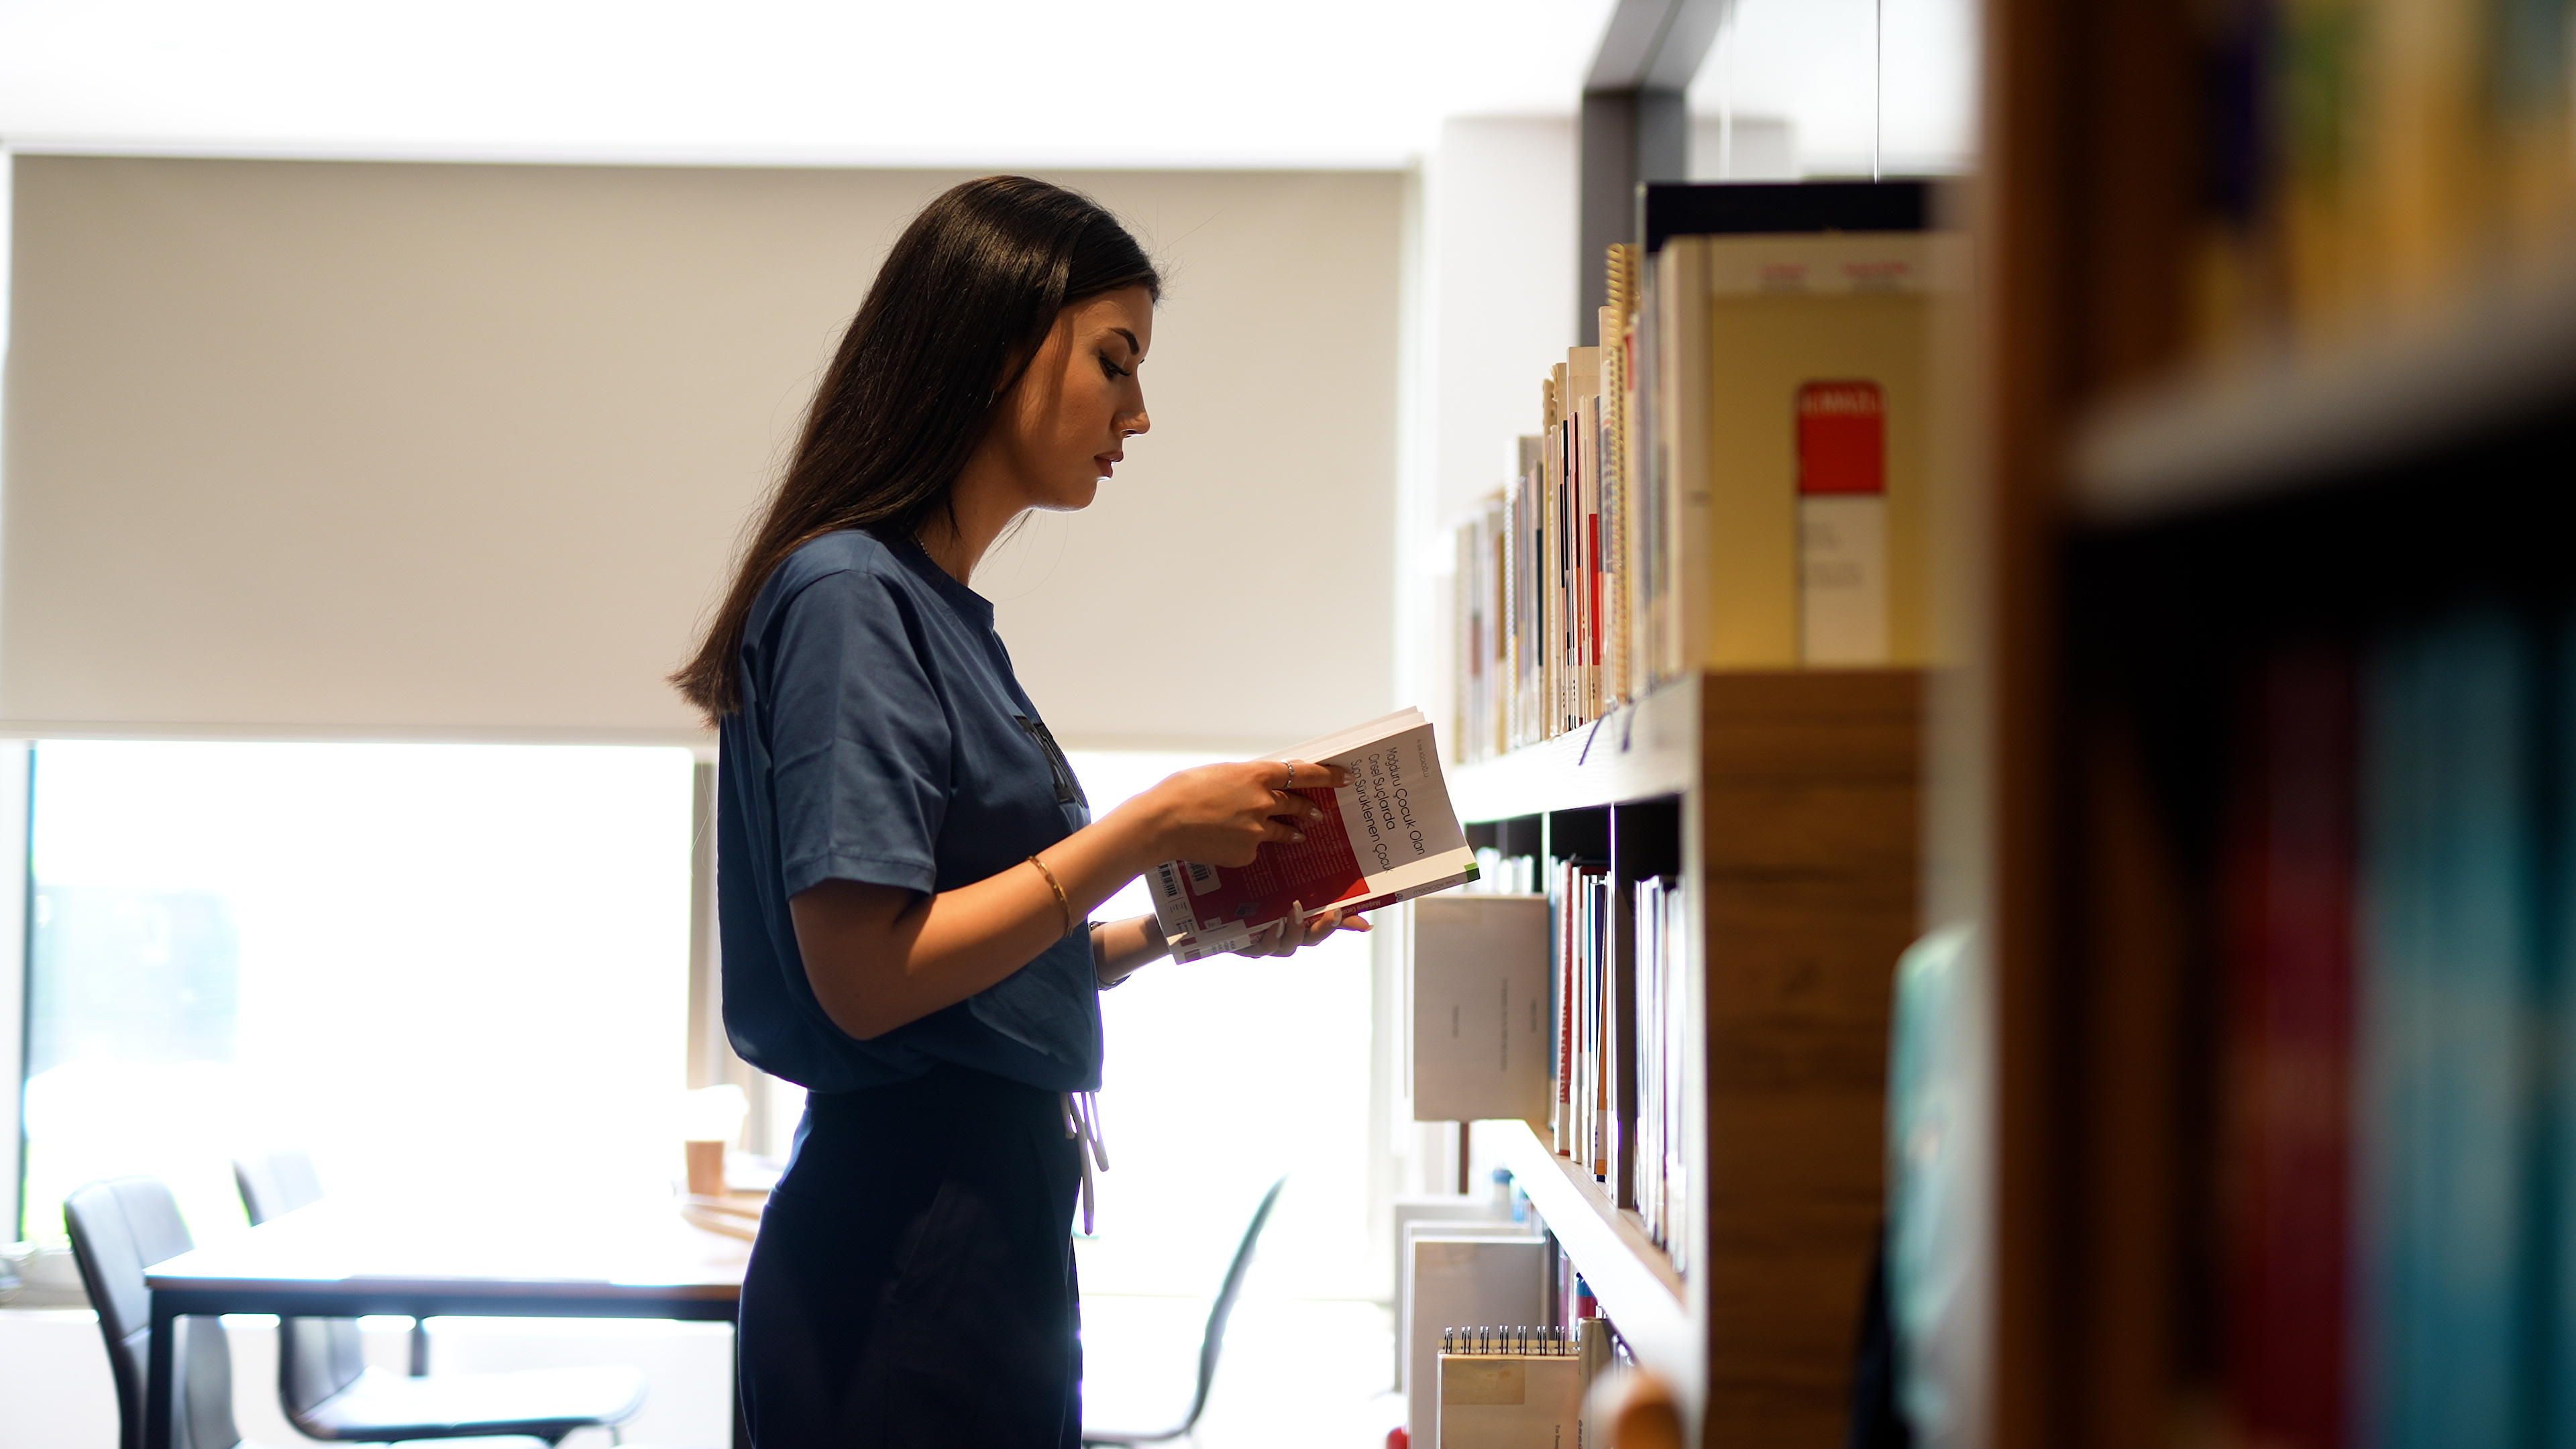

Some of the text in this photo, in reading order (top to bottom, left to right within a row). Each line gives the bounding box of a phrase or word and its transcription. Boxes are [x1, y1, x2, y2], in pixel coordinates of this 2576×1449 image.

[1354, 780, 1380, 842] Sürüklenen
[1373, 843, 1396, 873] Çocuk
[1368, 753, 1396, 830] Cinsel Suçlarda
[1385, 747, 1426, 855] Mağduru Çocuk Olan
